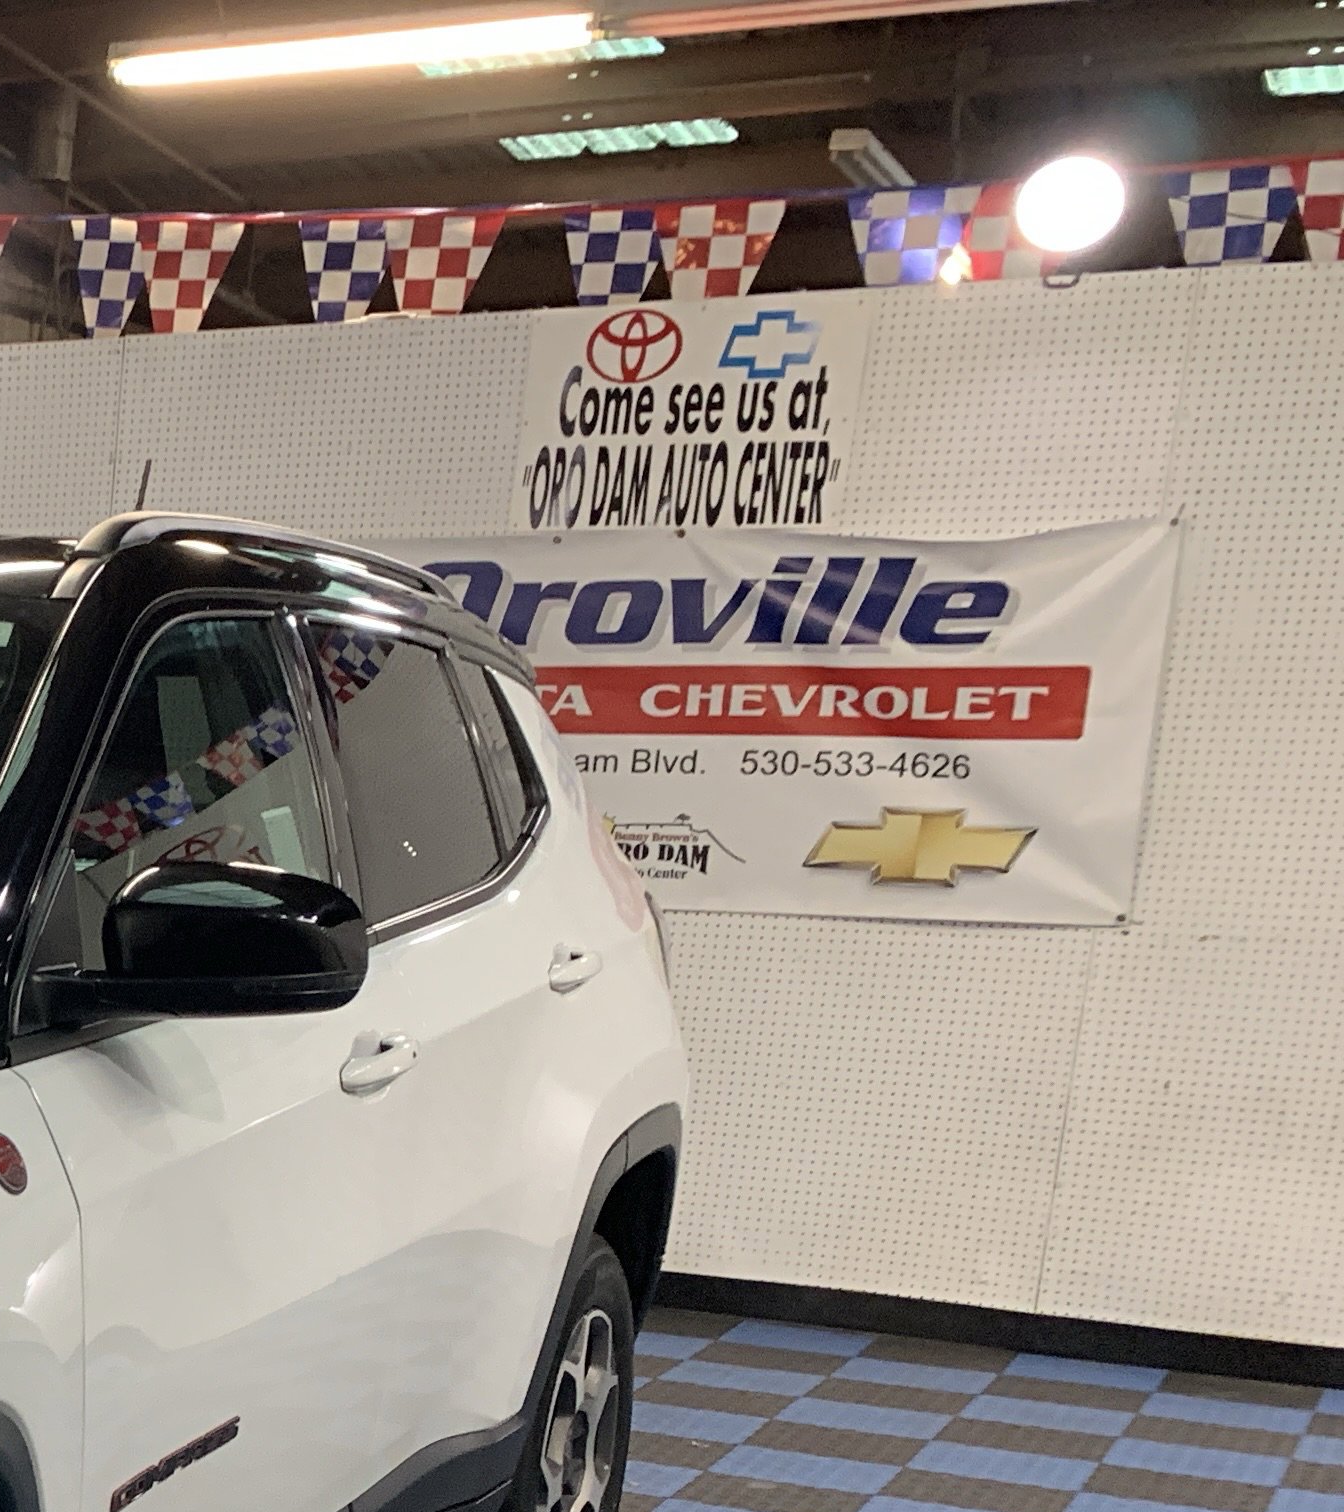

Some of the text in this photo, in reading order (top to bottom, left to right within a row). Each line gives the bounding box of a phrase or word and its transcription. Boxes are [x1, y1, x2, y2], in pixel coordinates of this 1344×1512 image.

[559, 365, 831, 437] Come see us at,
[588, 444, 653, 527] DAM
[654, 440, 728, 528] AUTO
[733, 440, 840, 527] CENTER"
[639, 683, 1048, 722] CHEVROLET
[574, 749, 972, 780] am Blvd. 530-533-4626
[647, 866, 688, 879] Center
[658, 844, 711, 875] DAM
